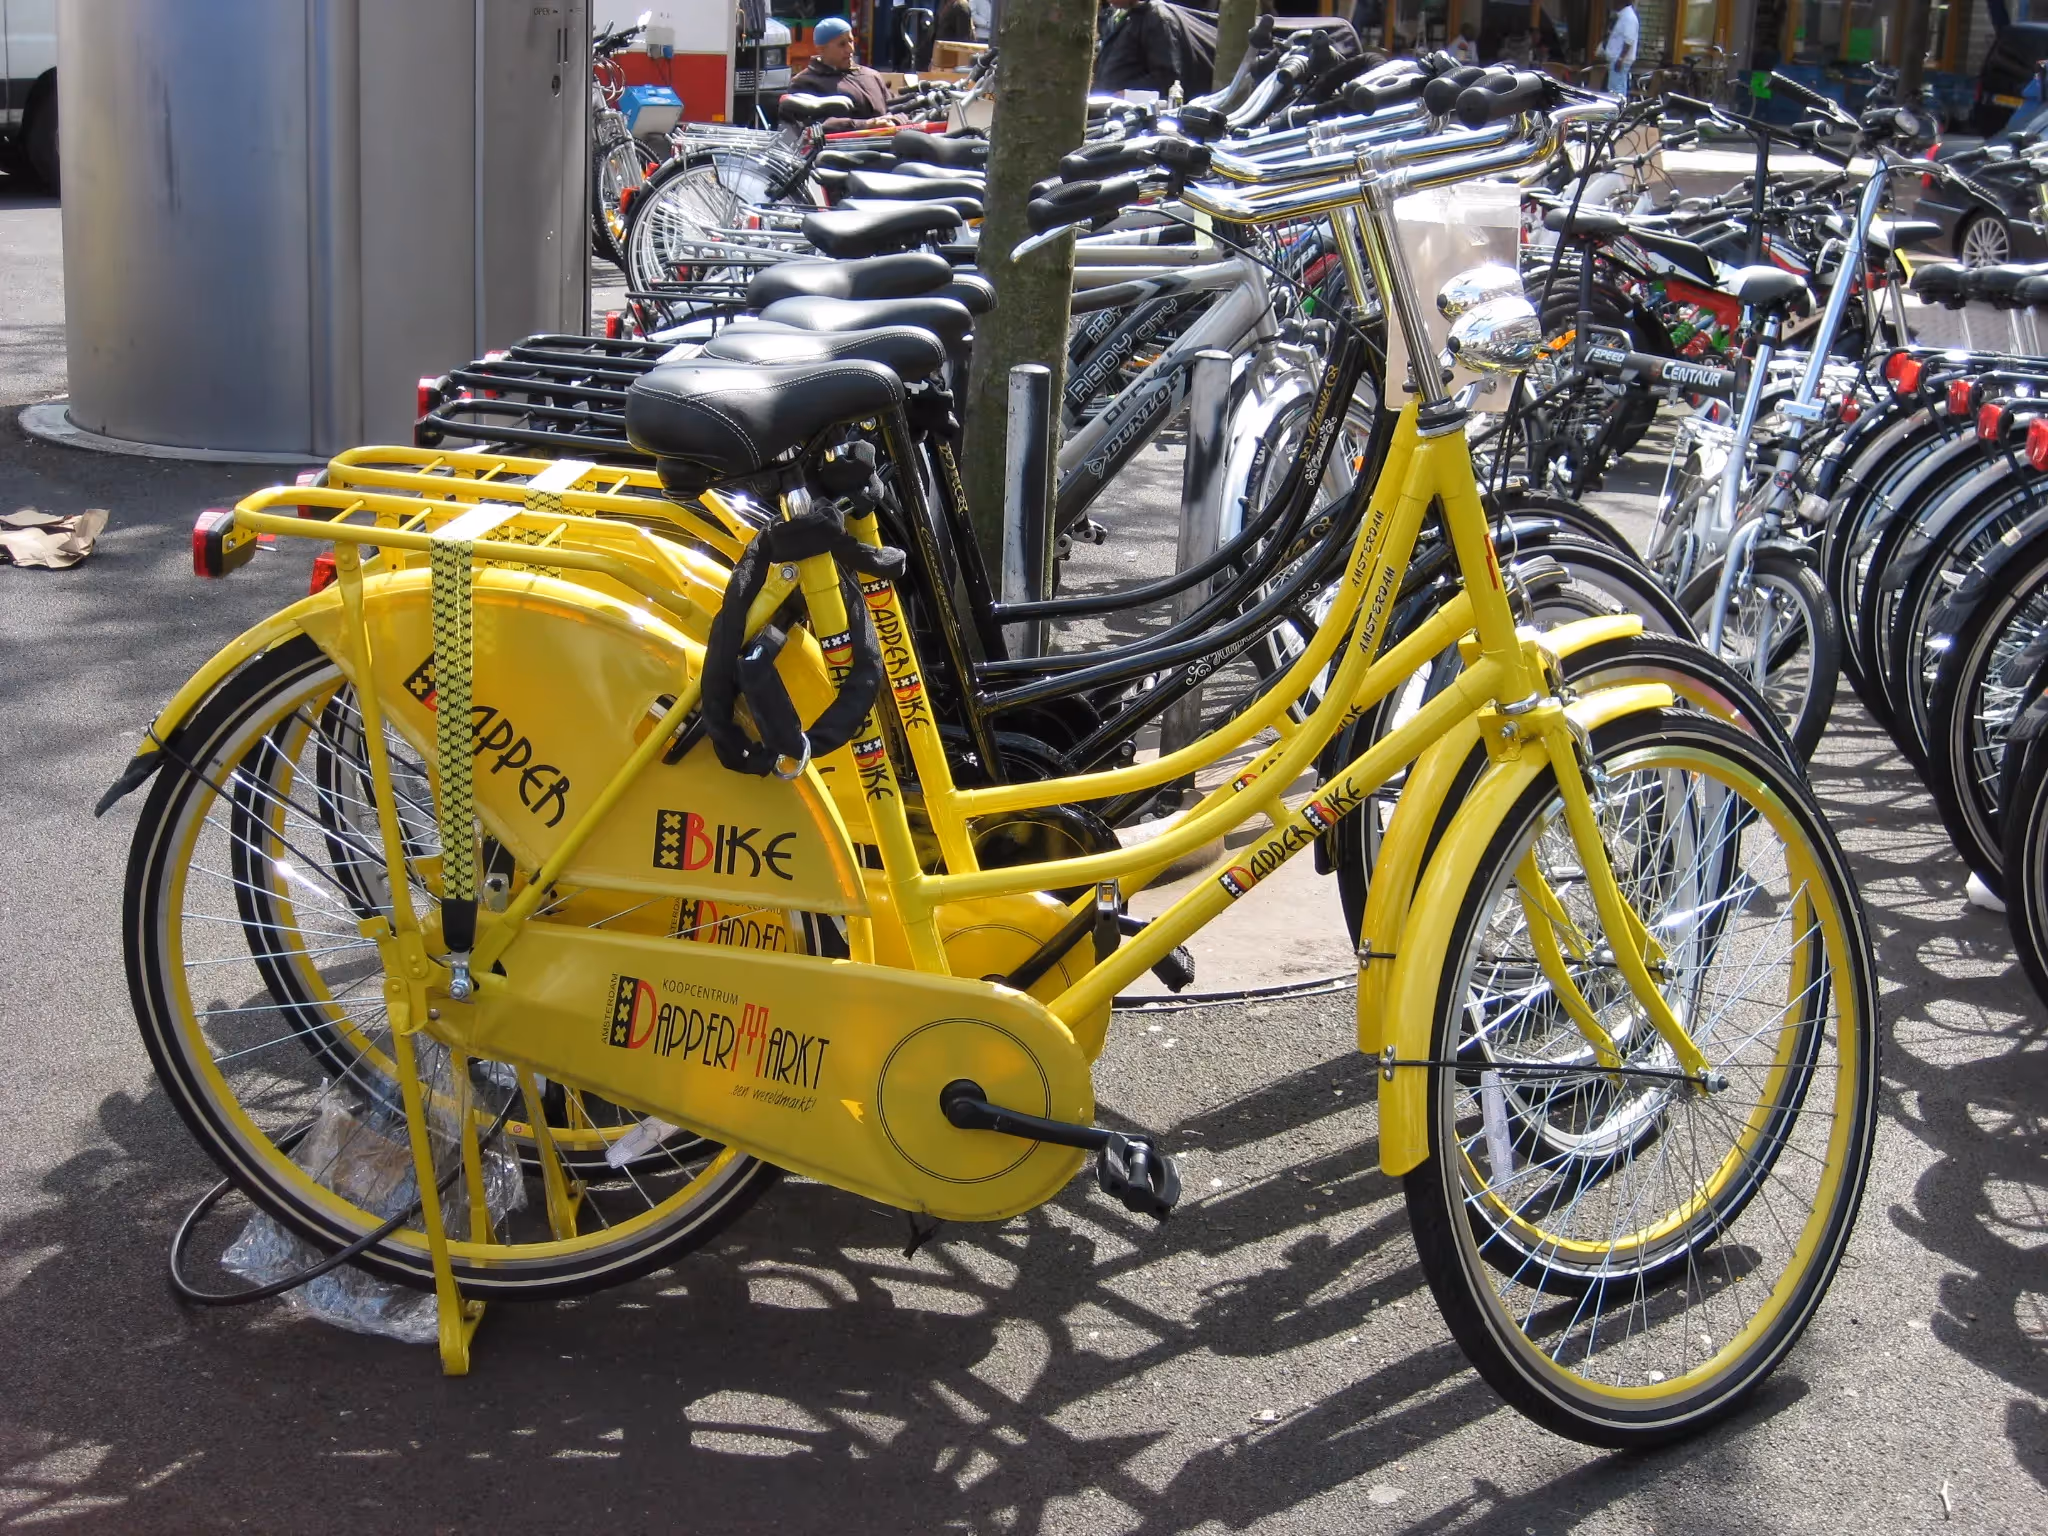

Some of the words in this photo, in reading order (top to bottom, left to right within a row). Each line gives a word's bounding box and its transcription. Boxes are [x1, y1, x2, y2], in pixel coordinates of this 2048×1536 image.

[1136, 298, 1177, 340] CITY
[1593, 348, 1626, 362] SPEED
[1662, 361, 1722, 388] CENTAUR
[1105, 365, 1184, 461] DUNLOP
[1352, 511, 1385, 588] AMSTERDAM
[1361, 566, 1397, 654] AMSTERDAM
[864, 587, 911, 675] DAPPER
[894, 683, 930, 732] BIKE
[423, 688, 571, 828] APPER
[854, 749, 894, 804] BIKE
[683, 810, 798, 881] BIKE
[1227, 824, 1318, 891] DAPPER
[1312, 776, 1367, 826] BIKE
[601, 972, 618, 1045] AMSTERDAM
[662, 978, 739, 1006] KOOPCENTRUM
